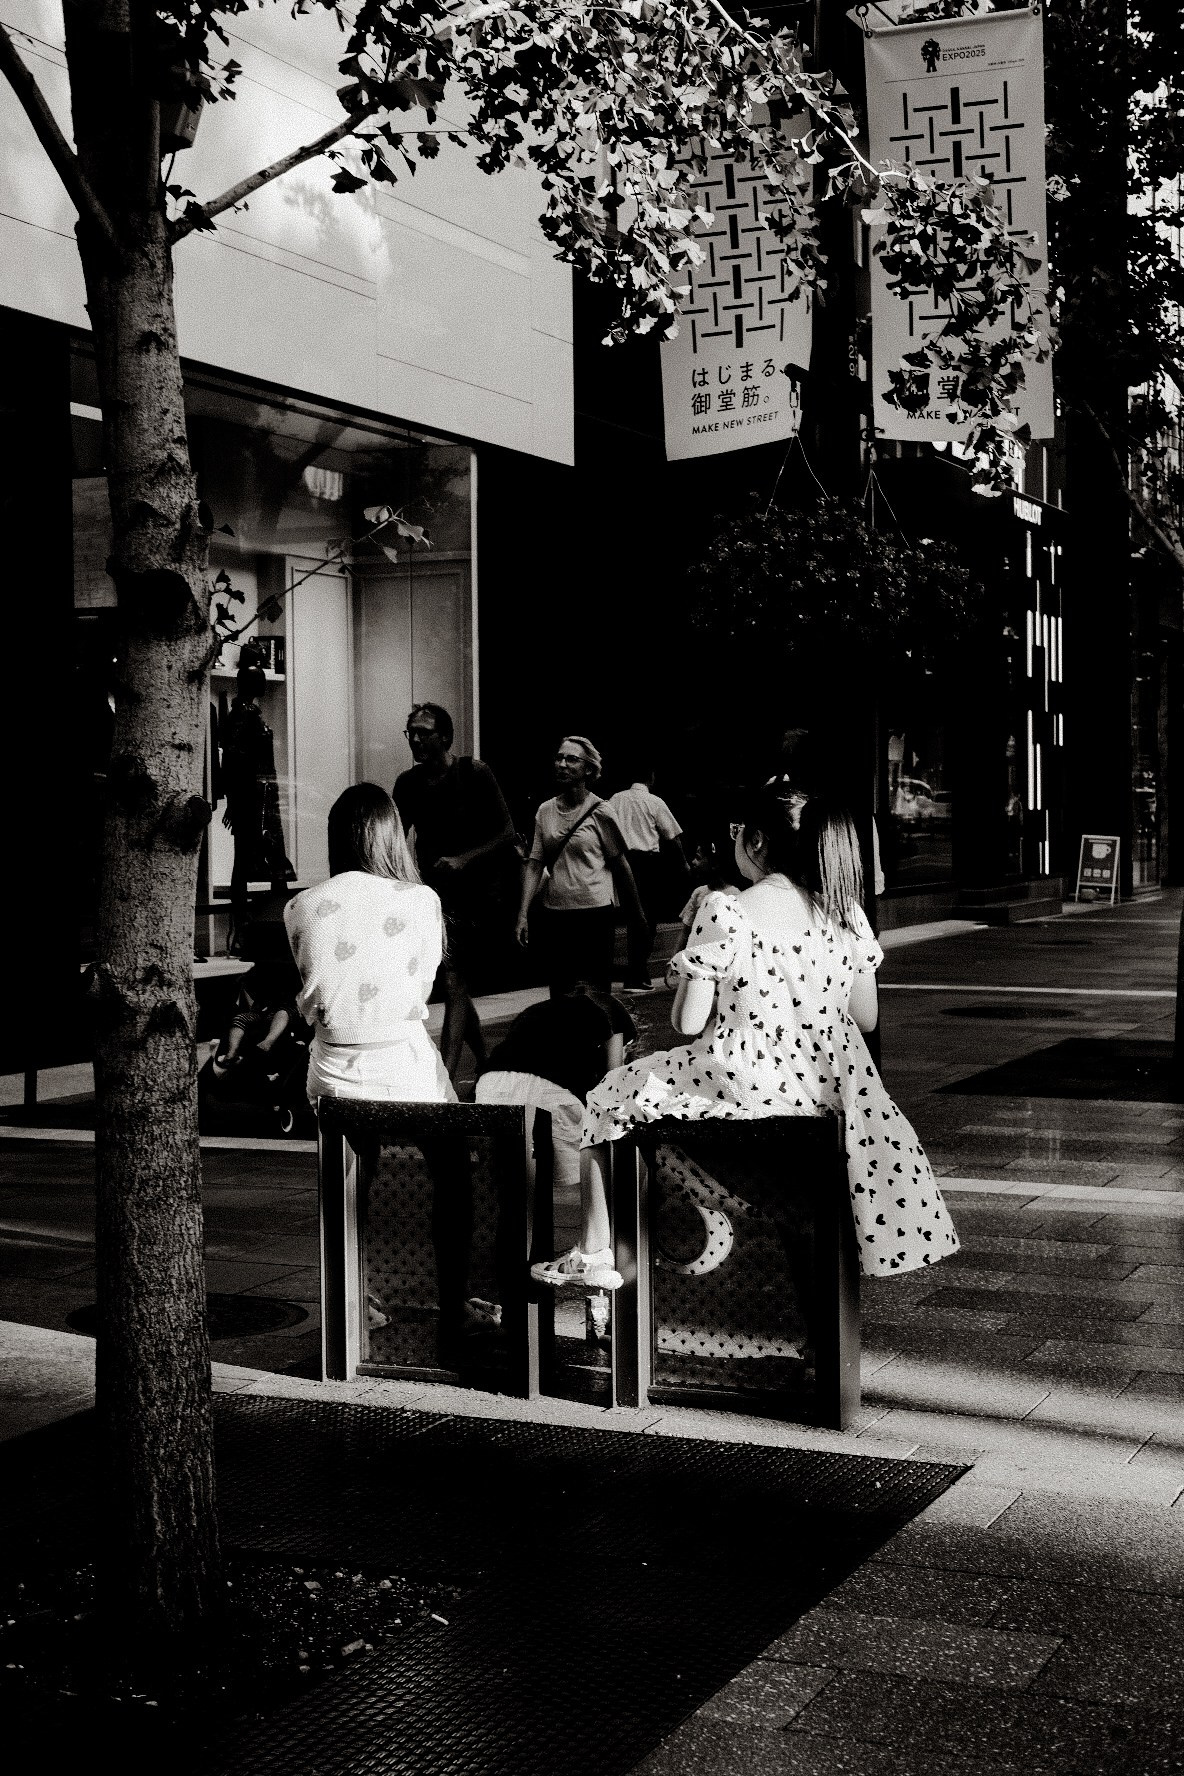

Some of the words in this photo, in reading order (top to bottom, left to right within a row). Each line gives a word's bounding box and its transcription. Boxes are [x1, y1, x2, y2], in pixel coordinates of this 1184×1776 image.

[942, 49, 986, 61] EXPO2025
[691, 385, 770, 417] 御堂筋。
[692, 422, 719, 435] MAKE
[723, 418, 744, 431] NEW
[746, 410, 779, 426] STREET
[906, 408, 941, 420] MAKE
